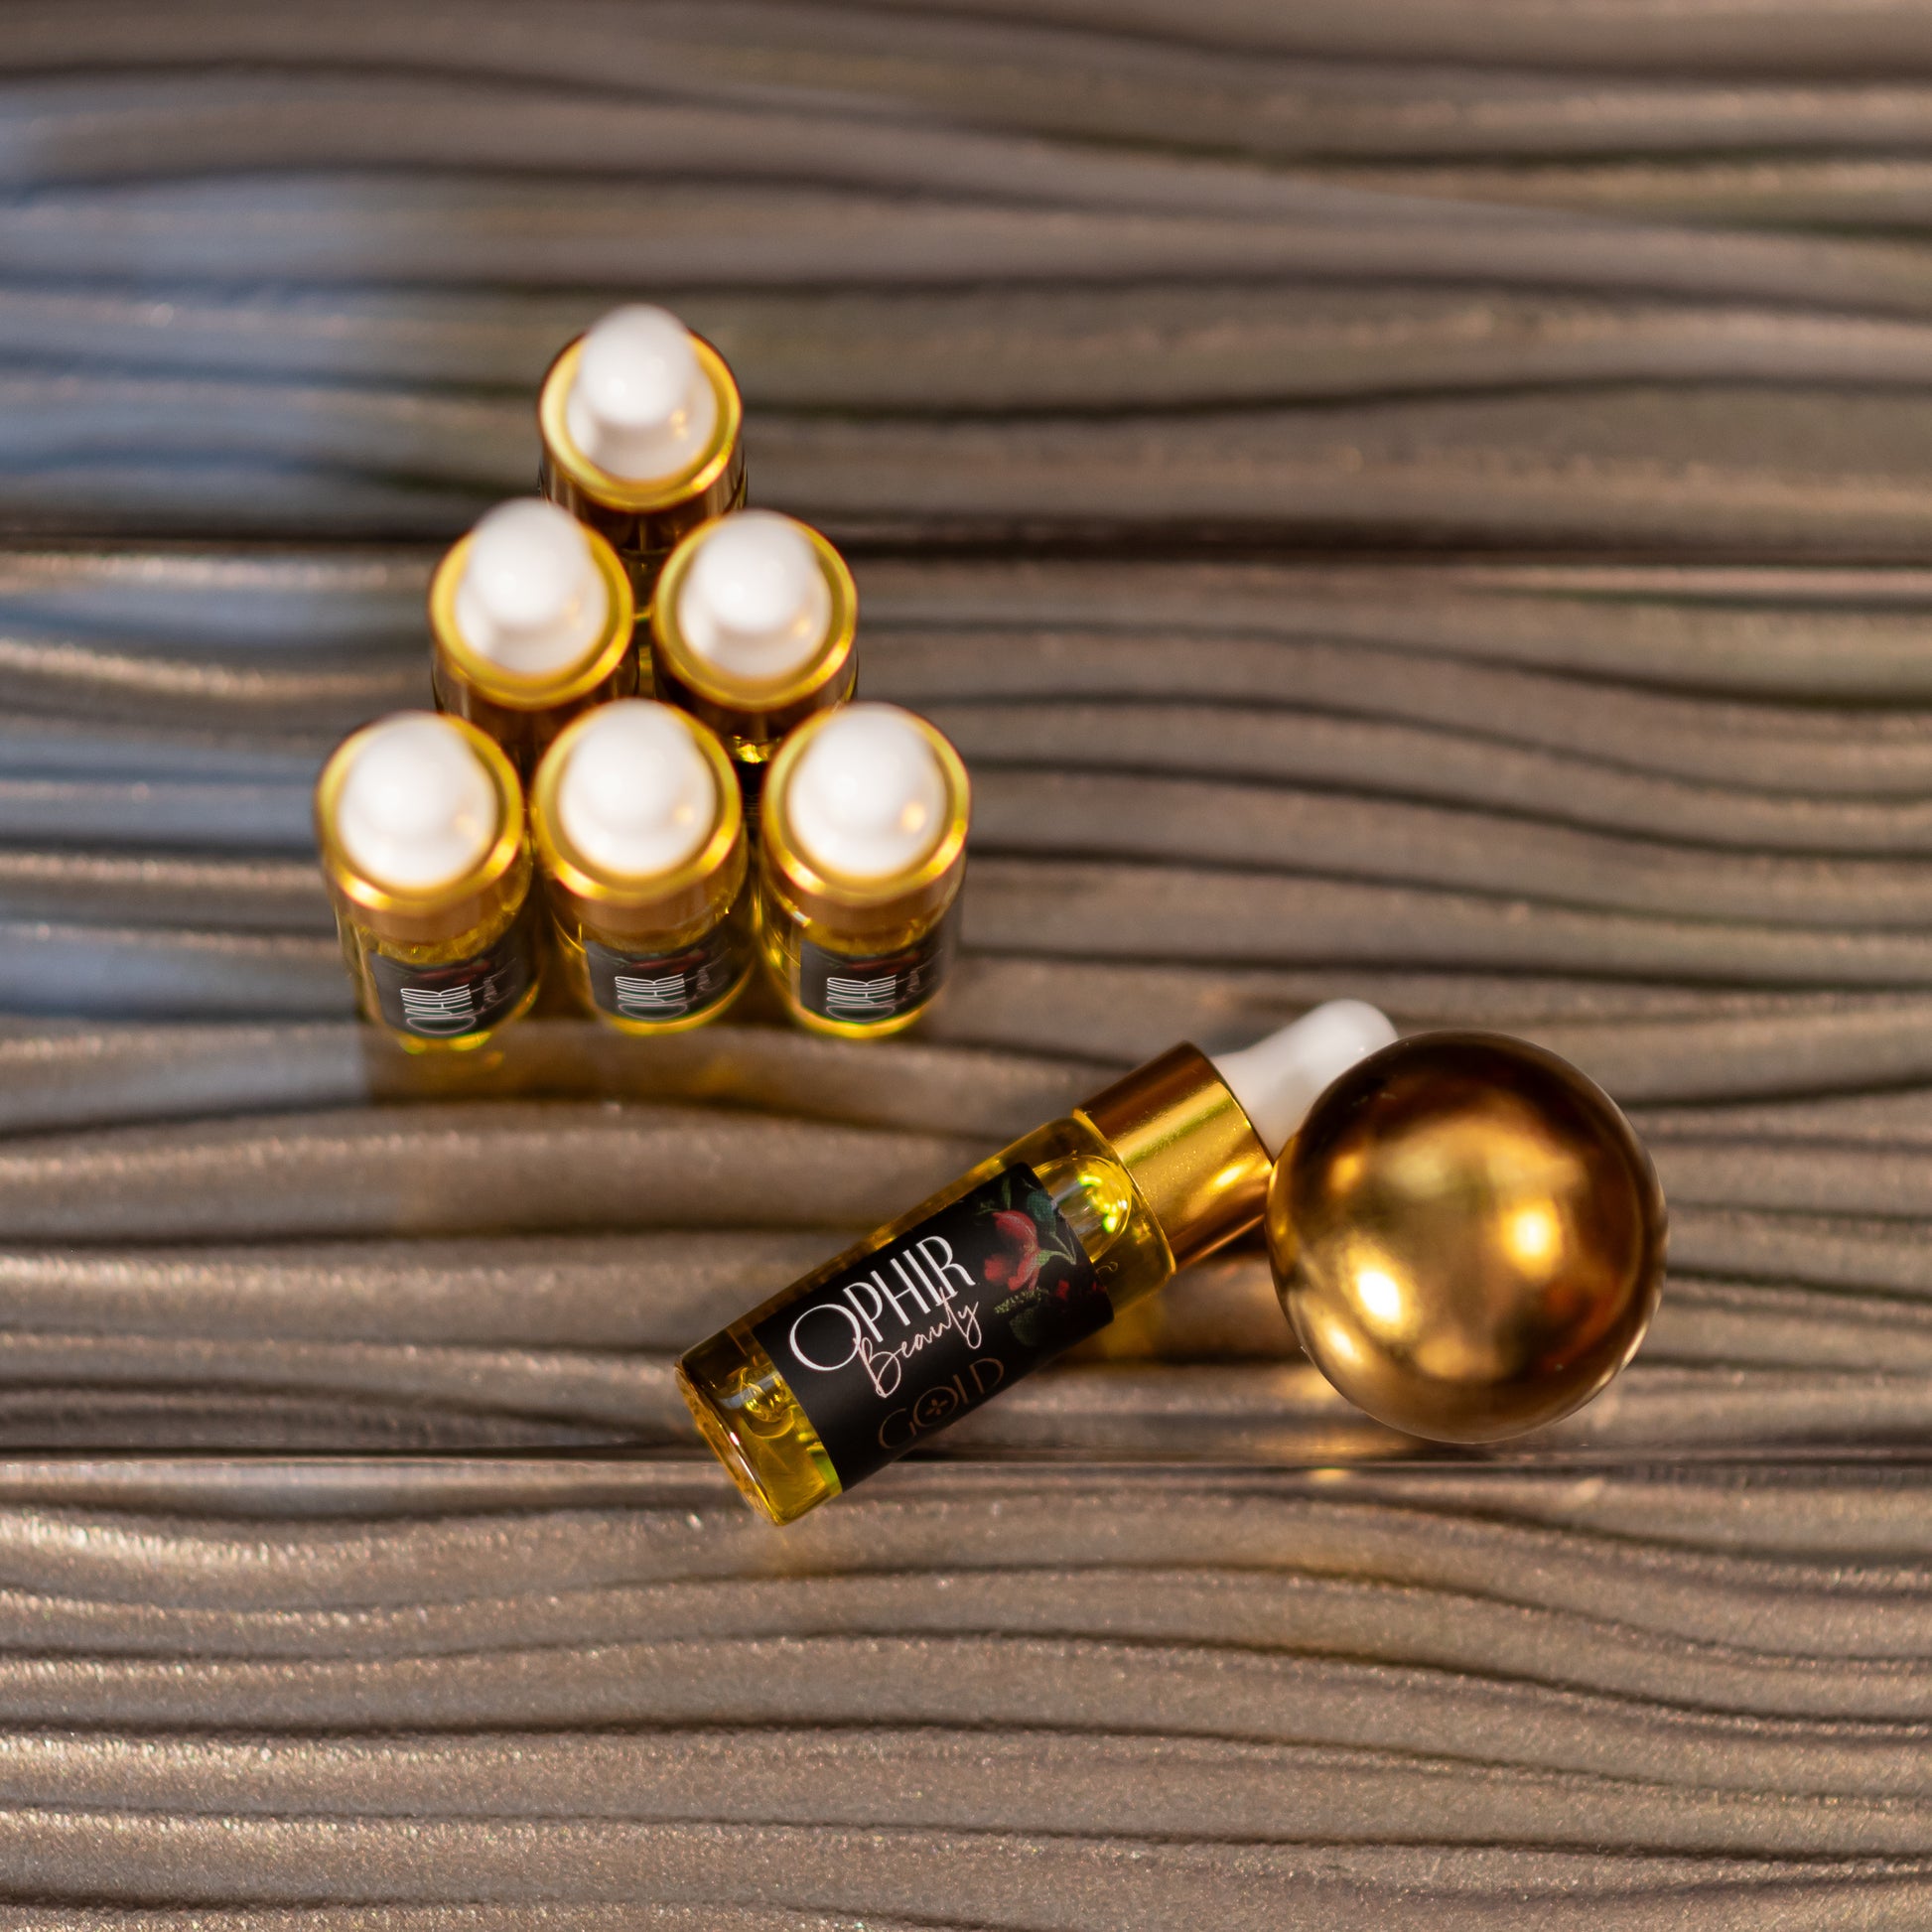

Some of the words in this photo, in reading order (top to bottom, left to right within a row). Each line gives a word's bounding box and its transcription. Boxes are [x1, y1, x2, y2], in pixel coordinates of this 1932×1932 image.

[789, 1235, 976, 1372] OPHIR
[854, 1289, 982, 1398] Beauty
[879, 1357, 1005, 1449] GOLD
